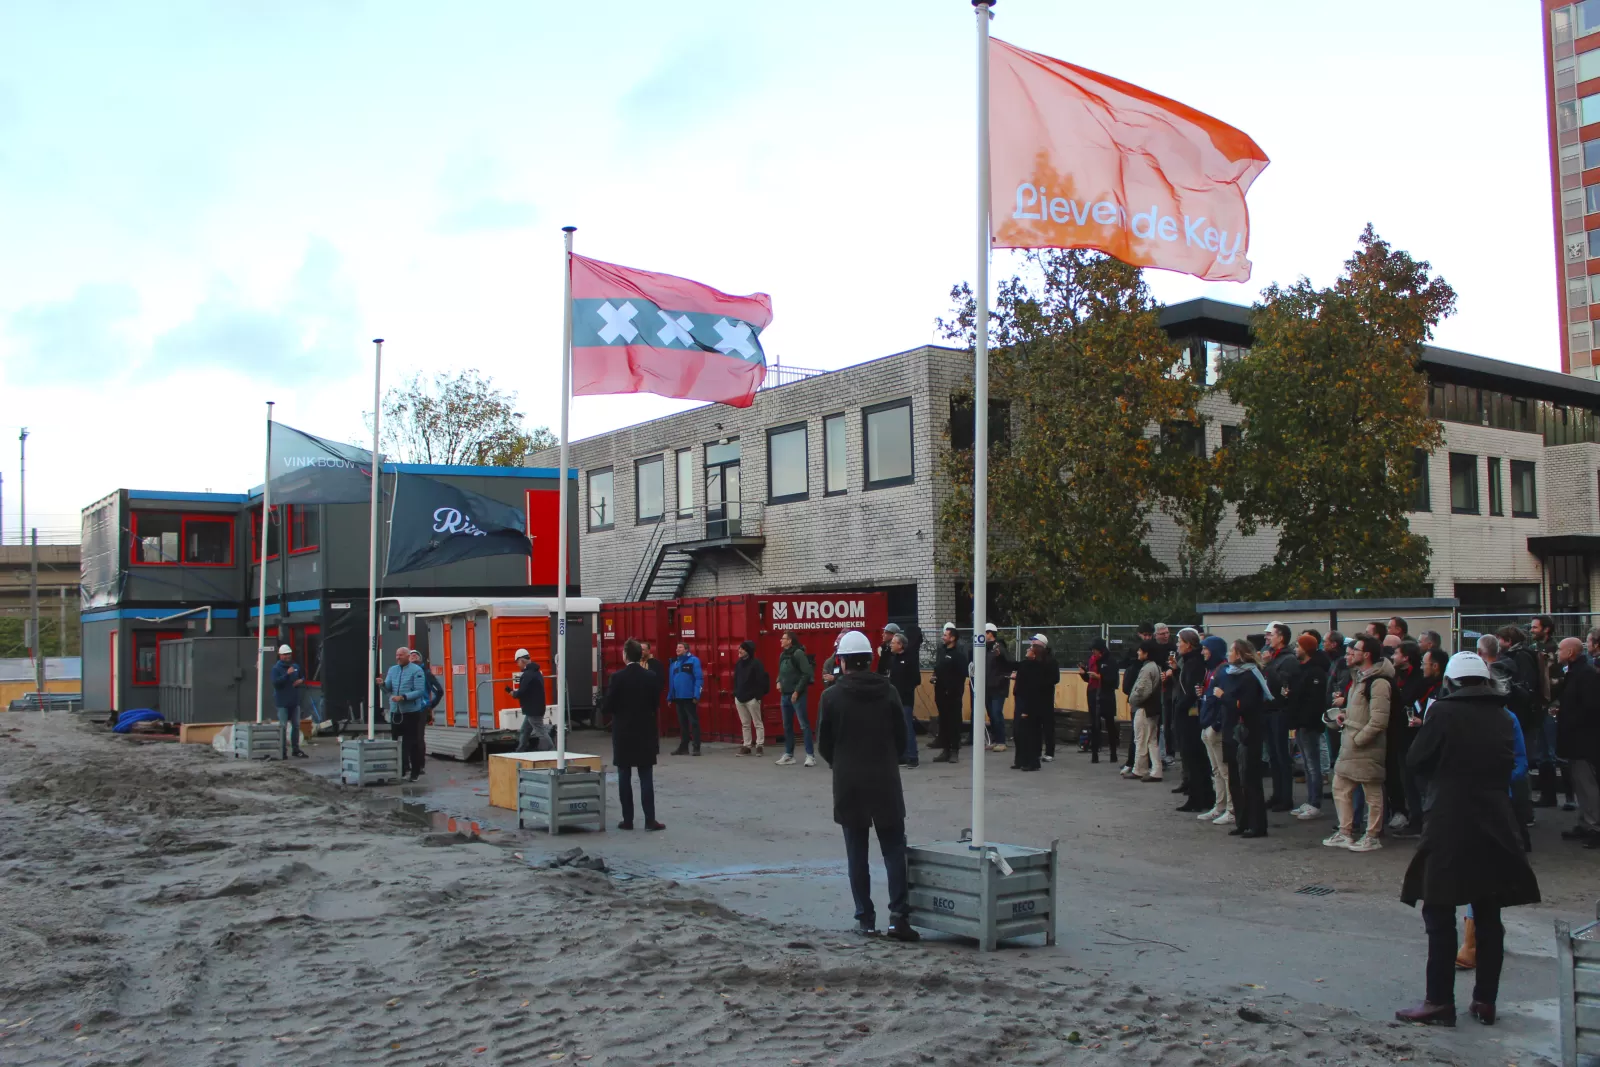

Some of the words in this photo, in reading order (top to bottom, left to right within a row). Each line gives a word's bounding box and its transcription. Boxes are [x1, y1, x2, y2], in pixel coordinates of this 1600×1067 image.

[1131, 205, 1178, 241] de
[1184, 216, 1241, 264] Key
[283, 456, 316, 468] VINK
[317, 457, 355, 469] BOUW
[792, 600, 865, 619] VROOM
[773, 621, 865, 630] FUNDERINGSTECHNIEKEN
[933, 897, 955, 910] RECO
[1012, 901, 1035, 913] RECO
